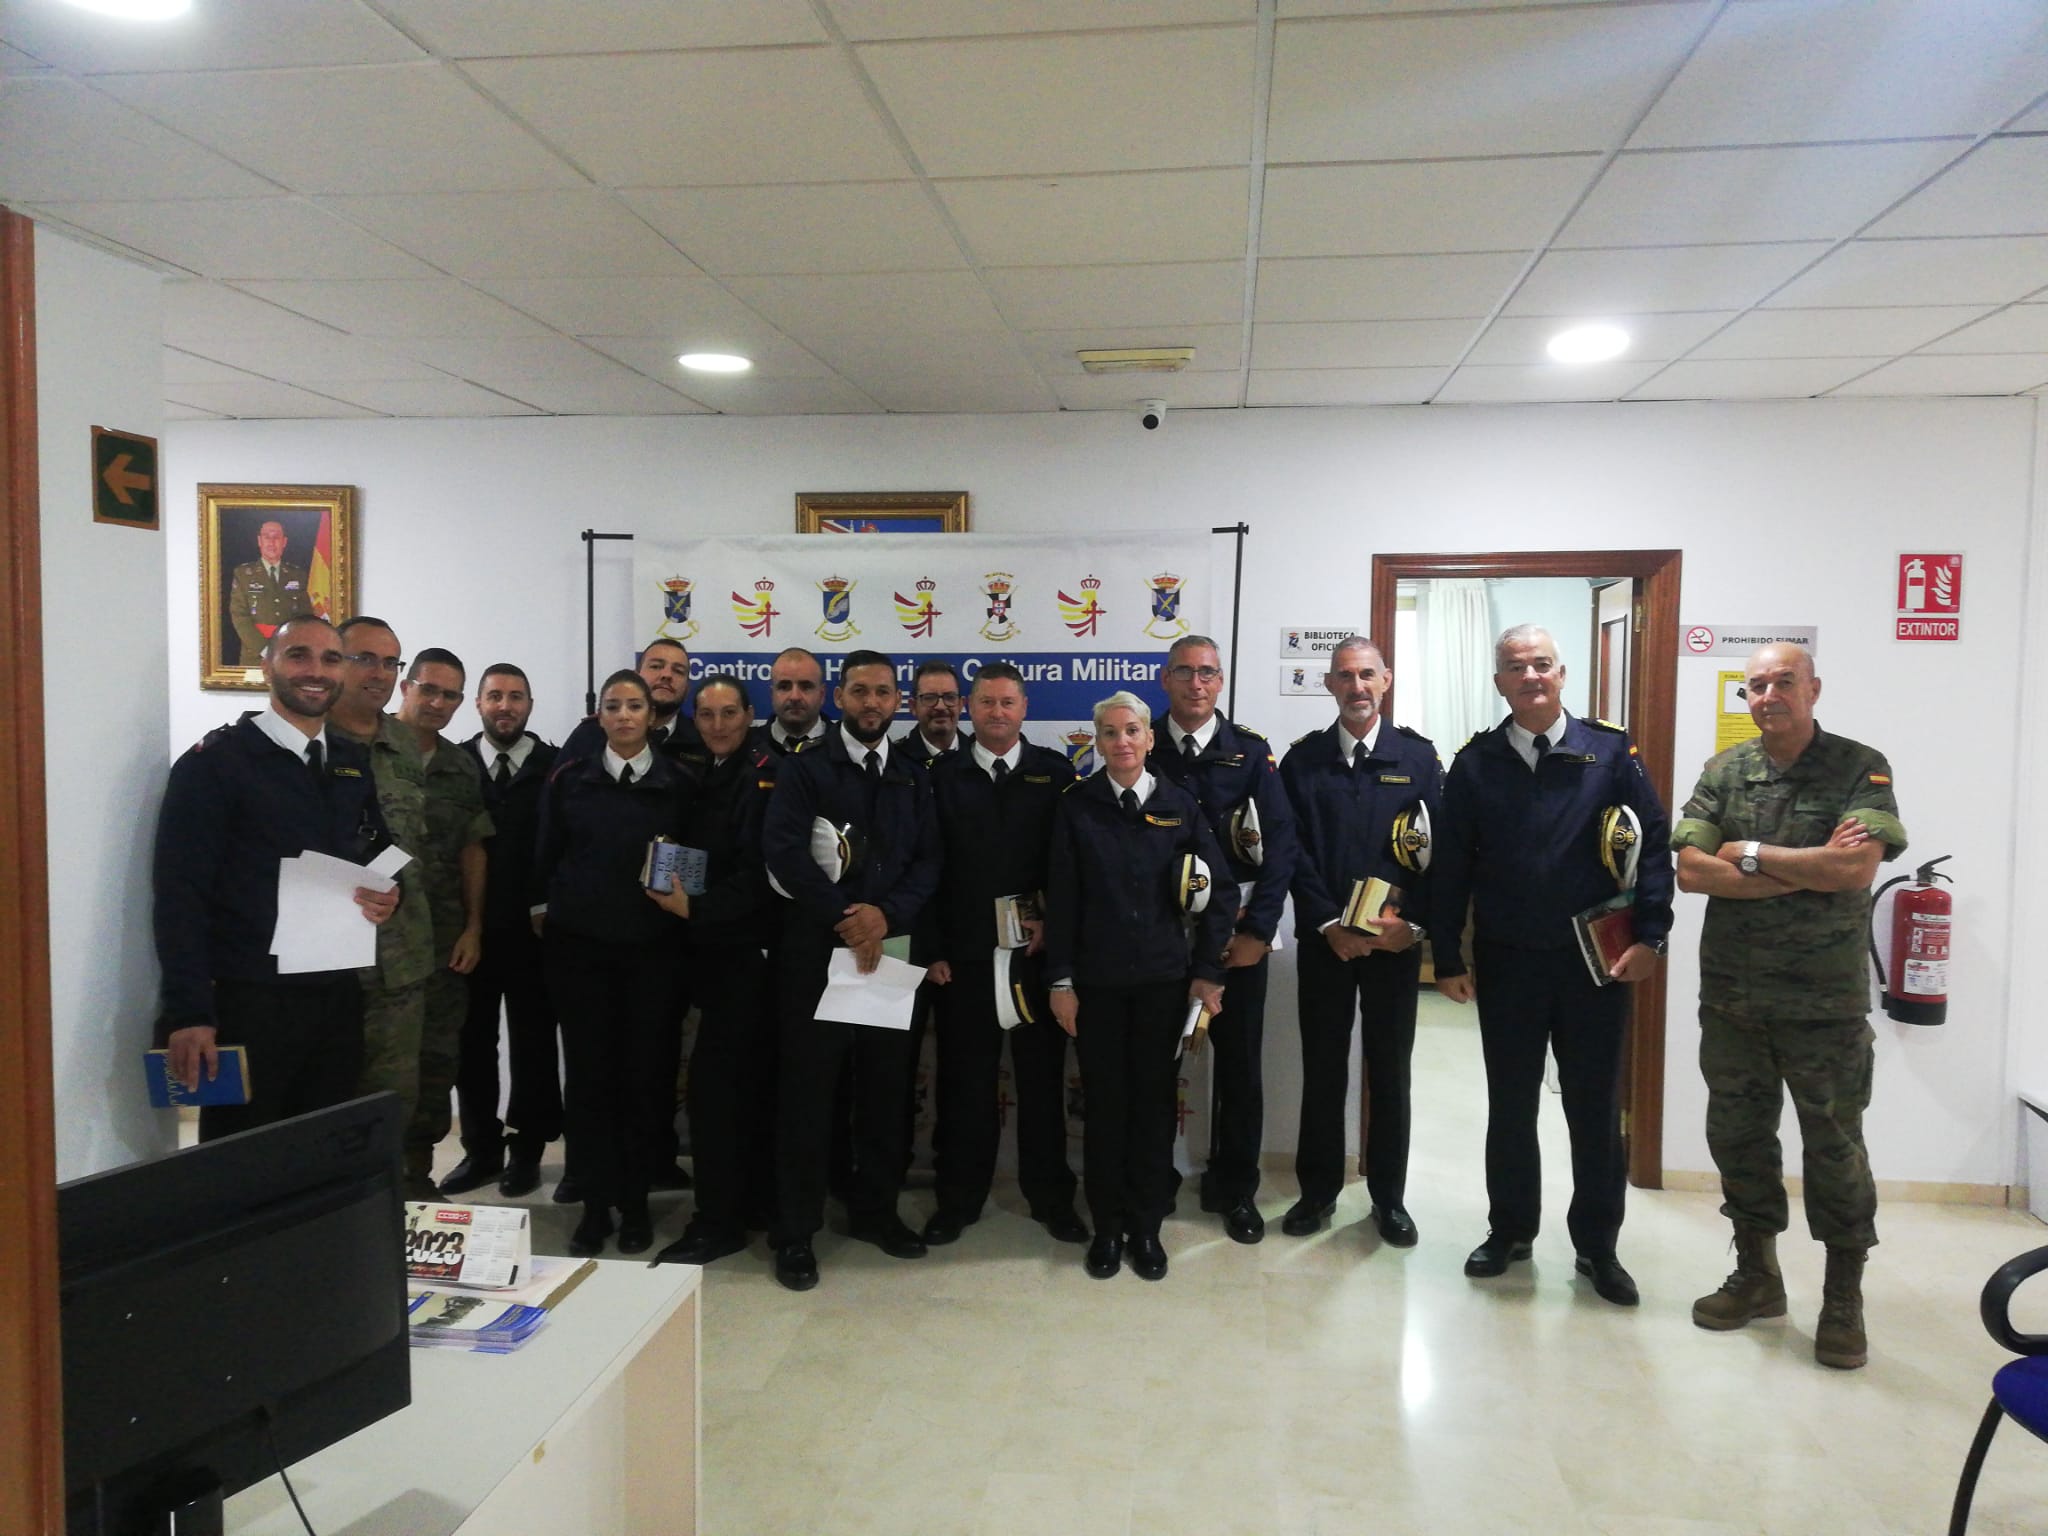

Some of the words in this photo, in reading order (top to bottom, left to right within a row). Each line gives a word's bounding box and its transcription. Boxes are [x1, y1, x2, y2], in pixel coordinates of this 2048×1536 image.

[1304, 631, 1355, 639] BIBLIOTECA
[1898, 622, 1956, 636] EXTINTOR
[1311, 643, 1338, 651] OFICI
[688, 657, 772, 681] Centro
[1072, 658, 1161, 681] Militar
[405, 1229, 464, 1265] 2023
